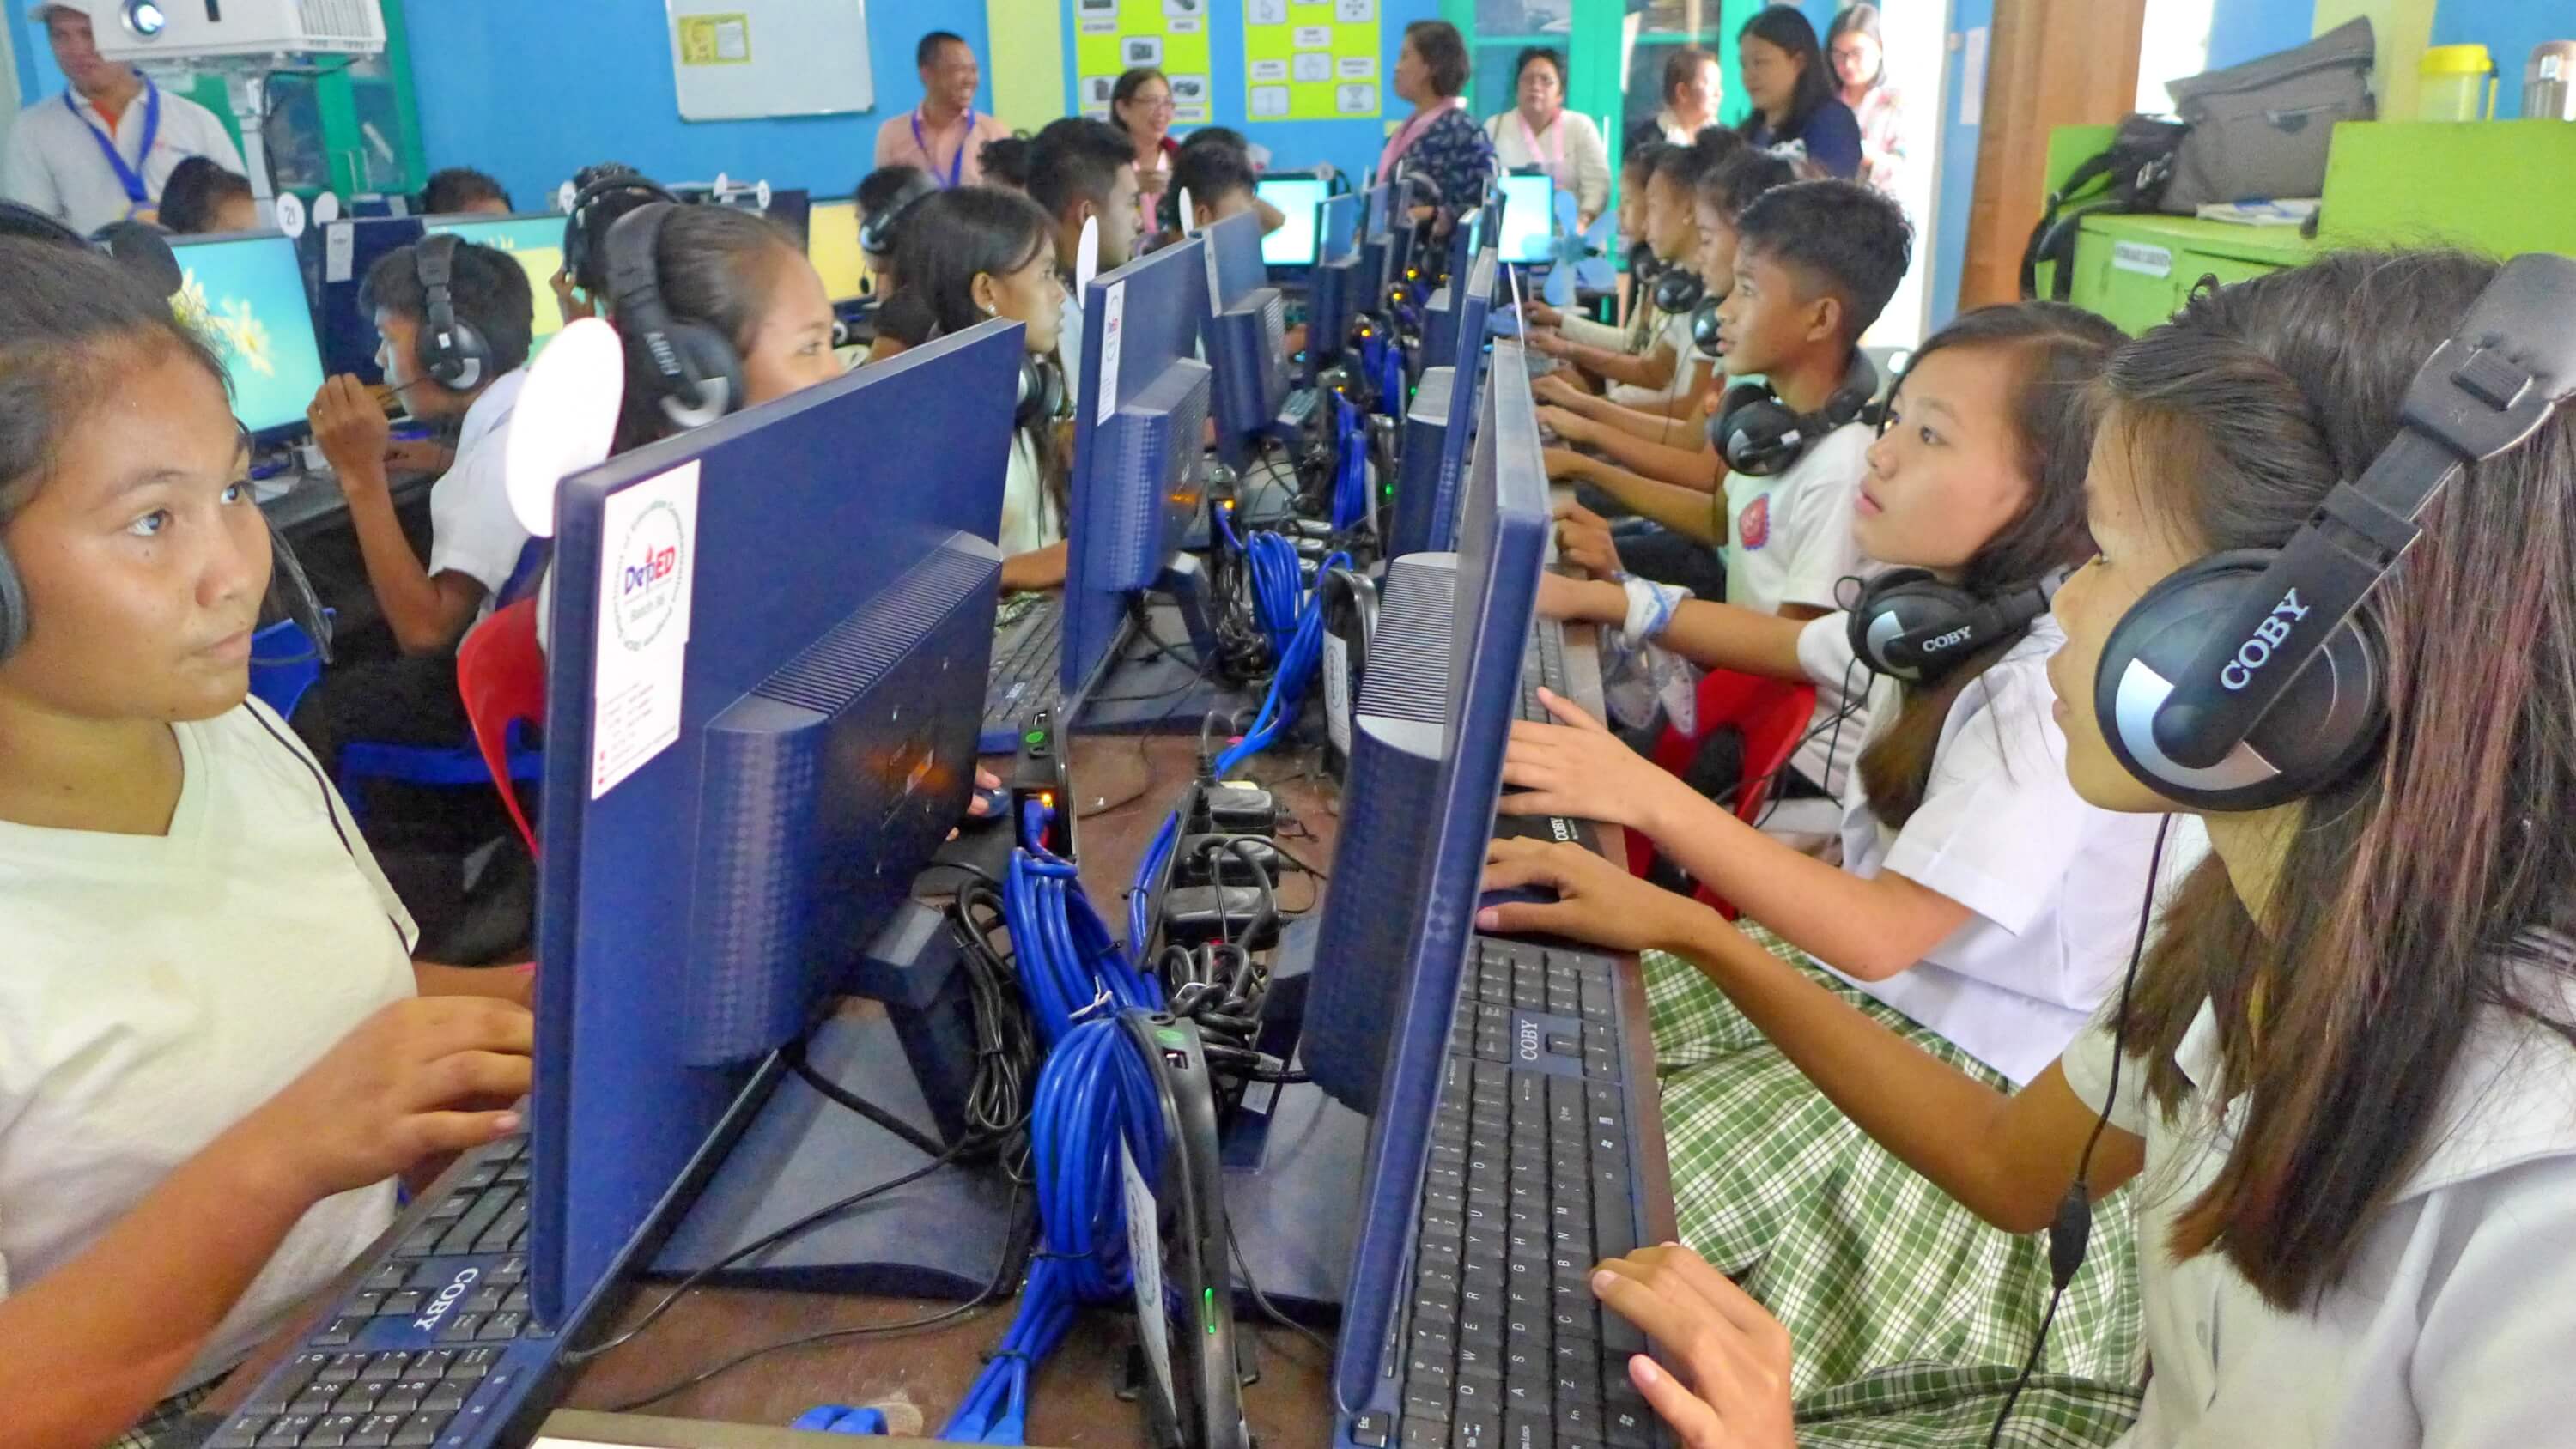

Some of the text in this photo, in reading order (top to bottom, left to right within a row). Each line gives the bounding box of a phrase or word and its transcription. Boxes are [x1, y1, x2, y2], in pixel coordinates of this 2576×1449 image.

[624, 546, 675, 595] DepED
[1923, 625, 1971, 652] COBY
[2221, 587, 2310, 690] COBY
[1550, 817, 1569, 840] COBY
[1520, 1019, 1538, 1061] COBY
[413, 1267, 479, 1331] COBY
[1358, 1416, 1370, 1429] Esc
